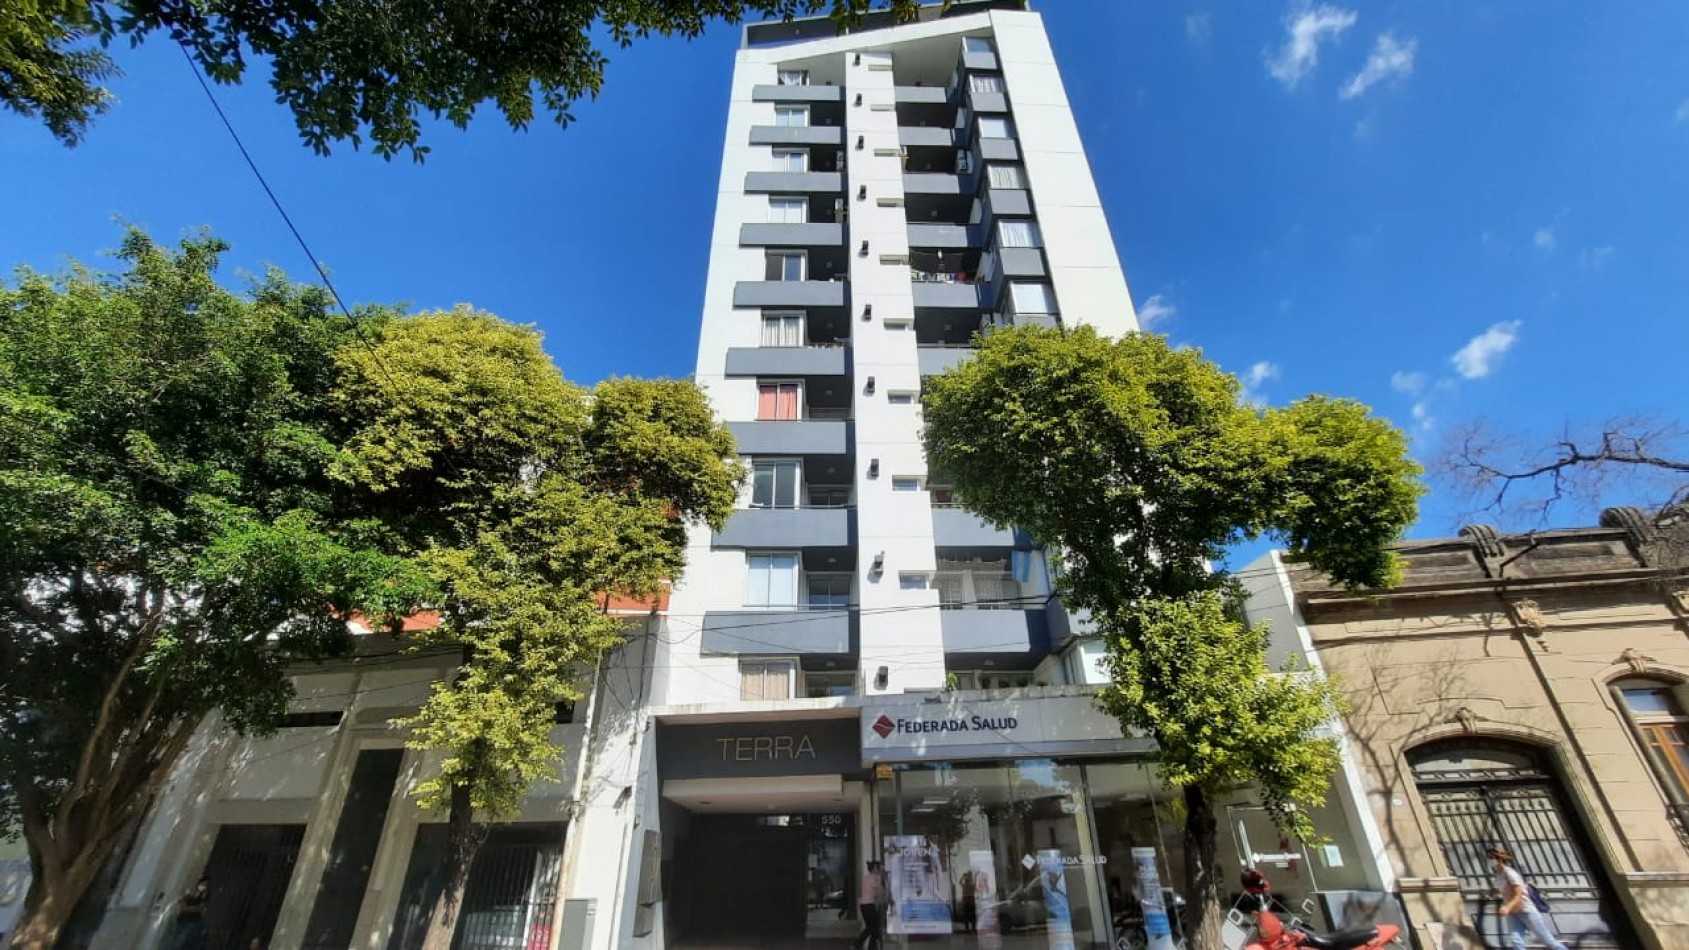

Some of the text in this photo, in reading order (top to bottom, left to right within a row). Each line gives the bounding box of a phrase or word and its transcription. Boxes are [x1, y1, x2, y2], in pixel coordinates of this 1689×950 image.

[897, 715, 1018, 733] FEDERADA SALUD
[717, 735, 816, 760] TERRA
